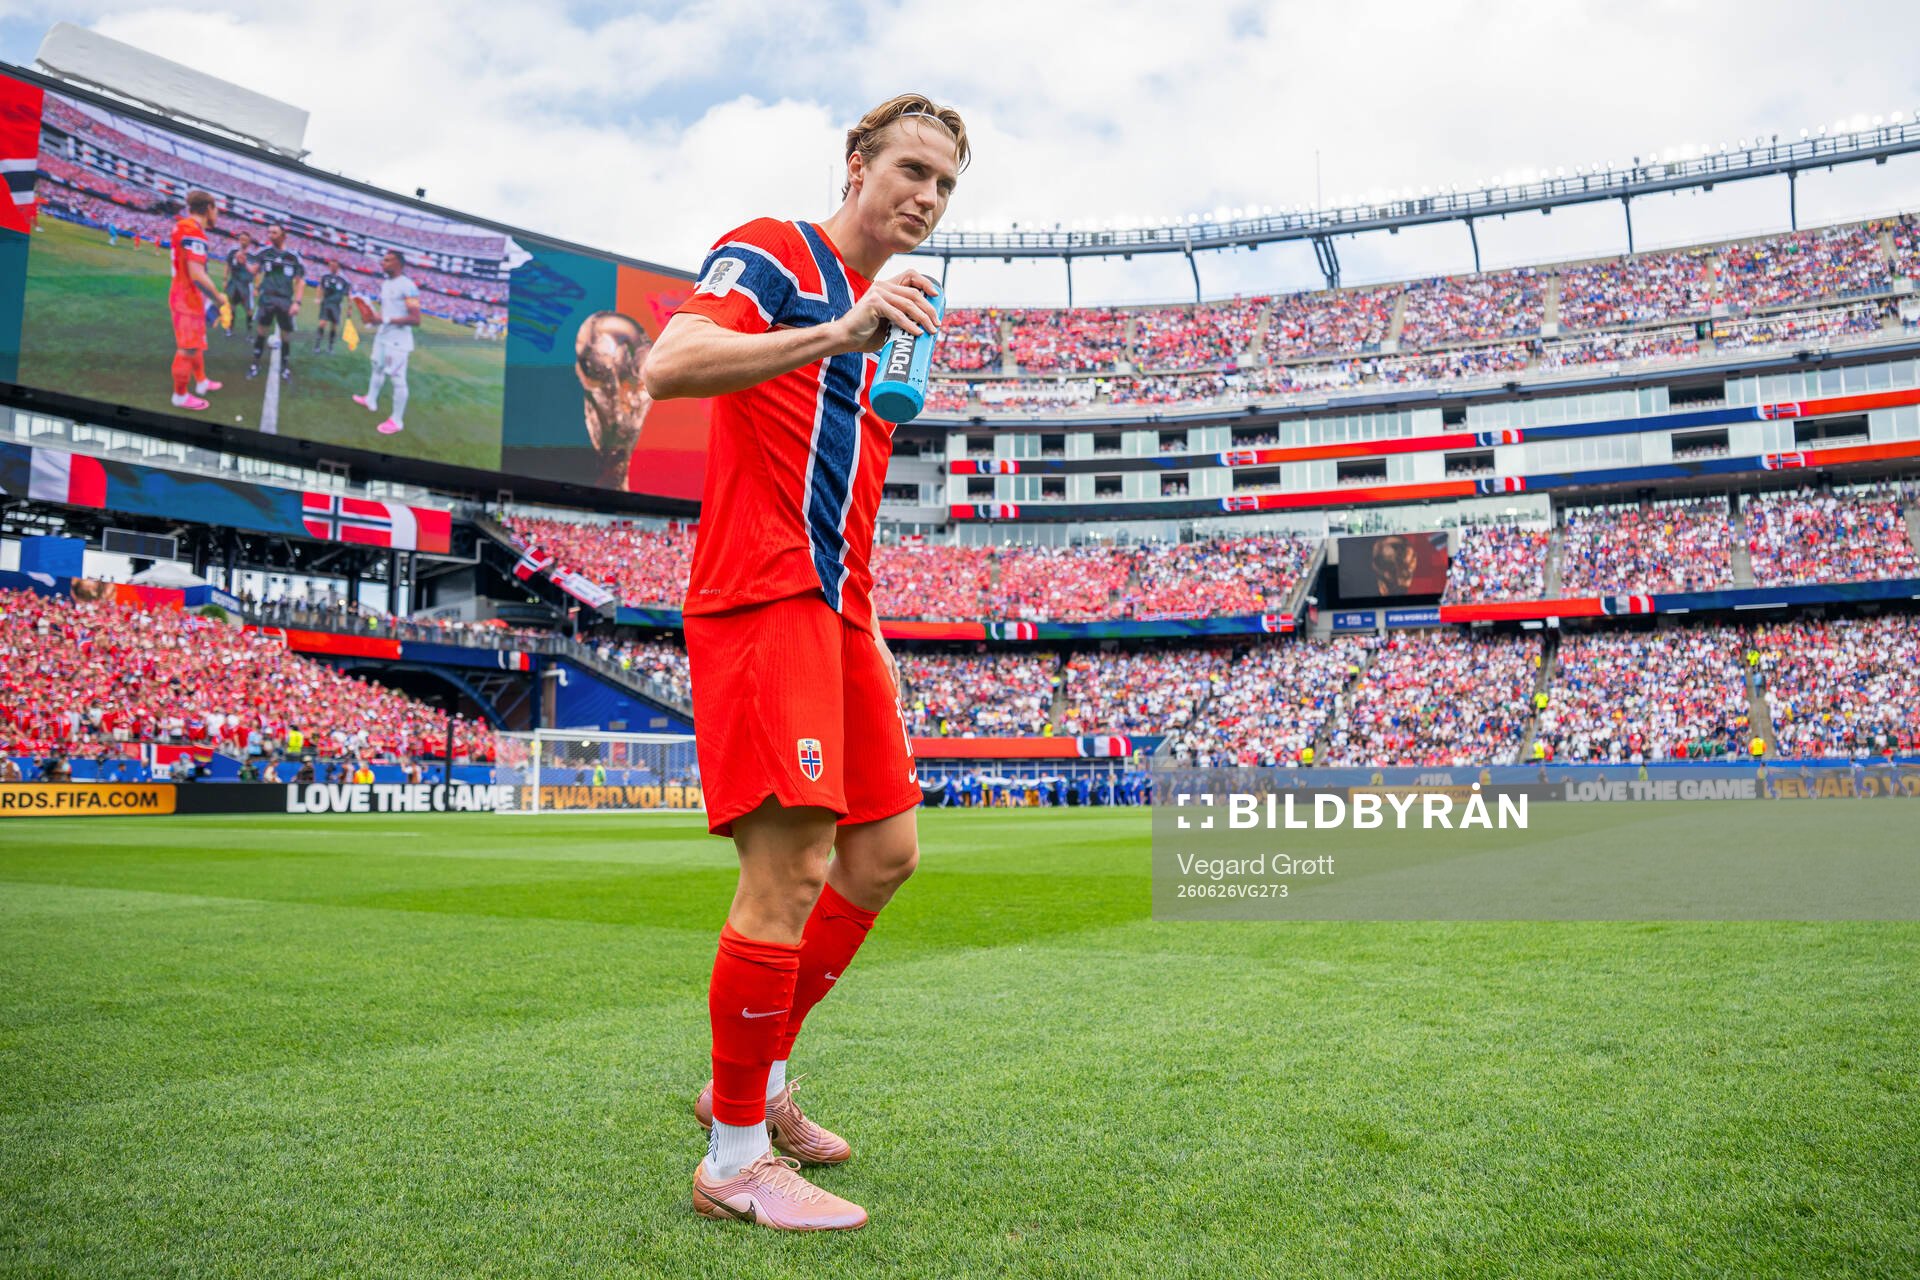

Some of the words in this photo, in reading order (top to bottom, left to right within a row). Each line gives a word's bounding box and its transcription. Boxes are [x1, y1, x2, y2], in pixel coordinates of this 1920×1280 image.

[888, 329, 916, 375] POWE
[1419, 773, 1454, 786] FIFA
[1565, 780, 1628, 801] LOVE
[1628, 780, 1678, 800] THE
[1679, 778, 1757, 800] GAME
[286, 783, 370, 813] LOVE
[373, 783, 432, 812] THE
[433, 784, 515, 812] GAME
[626, 785, 684, 809] YOUR
